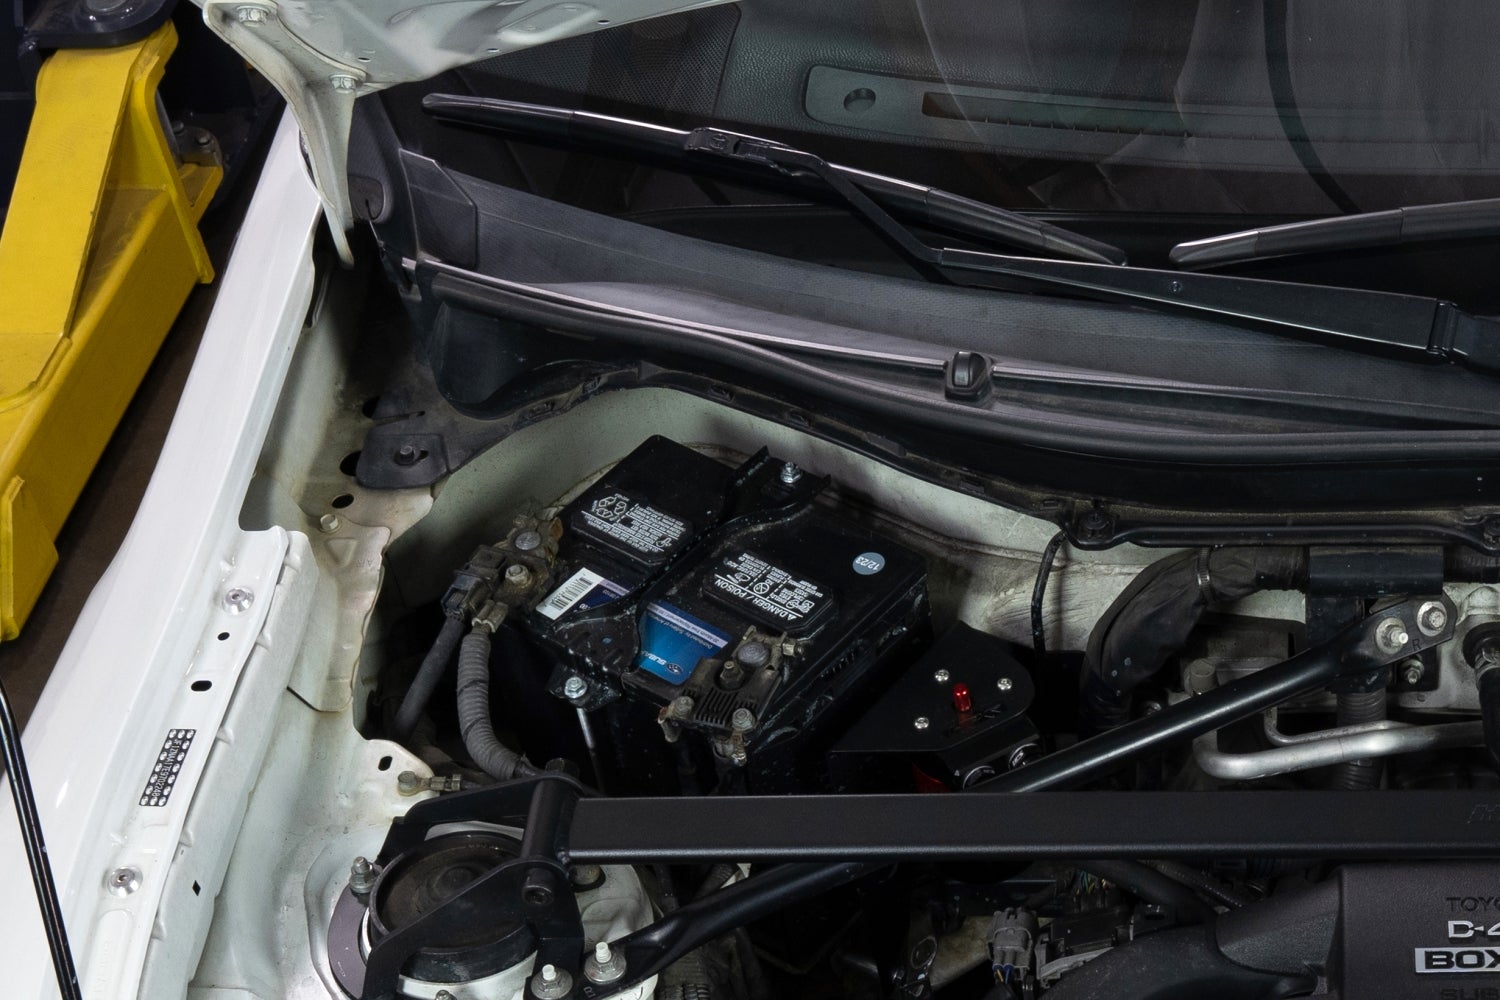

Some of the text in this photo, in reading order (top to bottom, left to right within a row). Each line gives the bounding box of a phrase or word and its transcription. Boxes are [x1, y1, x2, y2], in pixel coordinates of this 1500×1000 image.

[855, 556, 881, 571] 12/23
[714, 579, 748, 598] POISON
[752, 597, 789, 618] DANGER
[641, 650, 667, 666] SUBA
